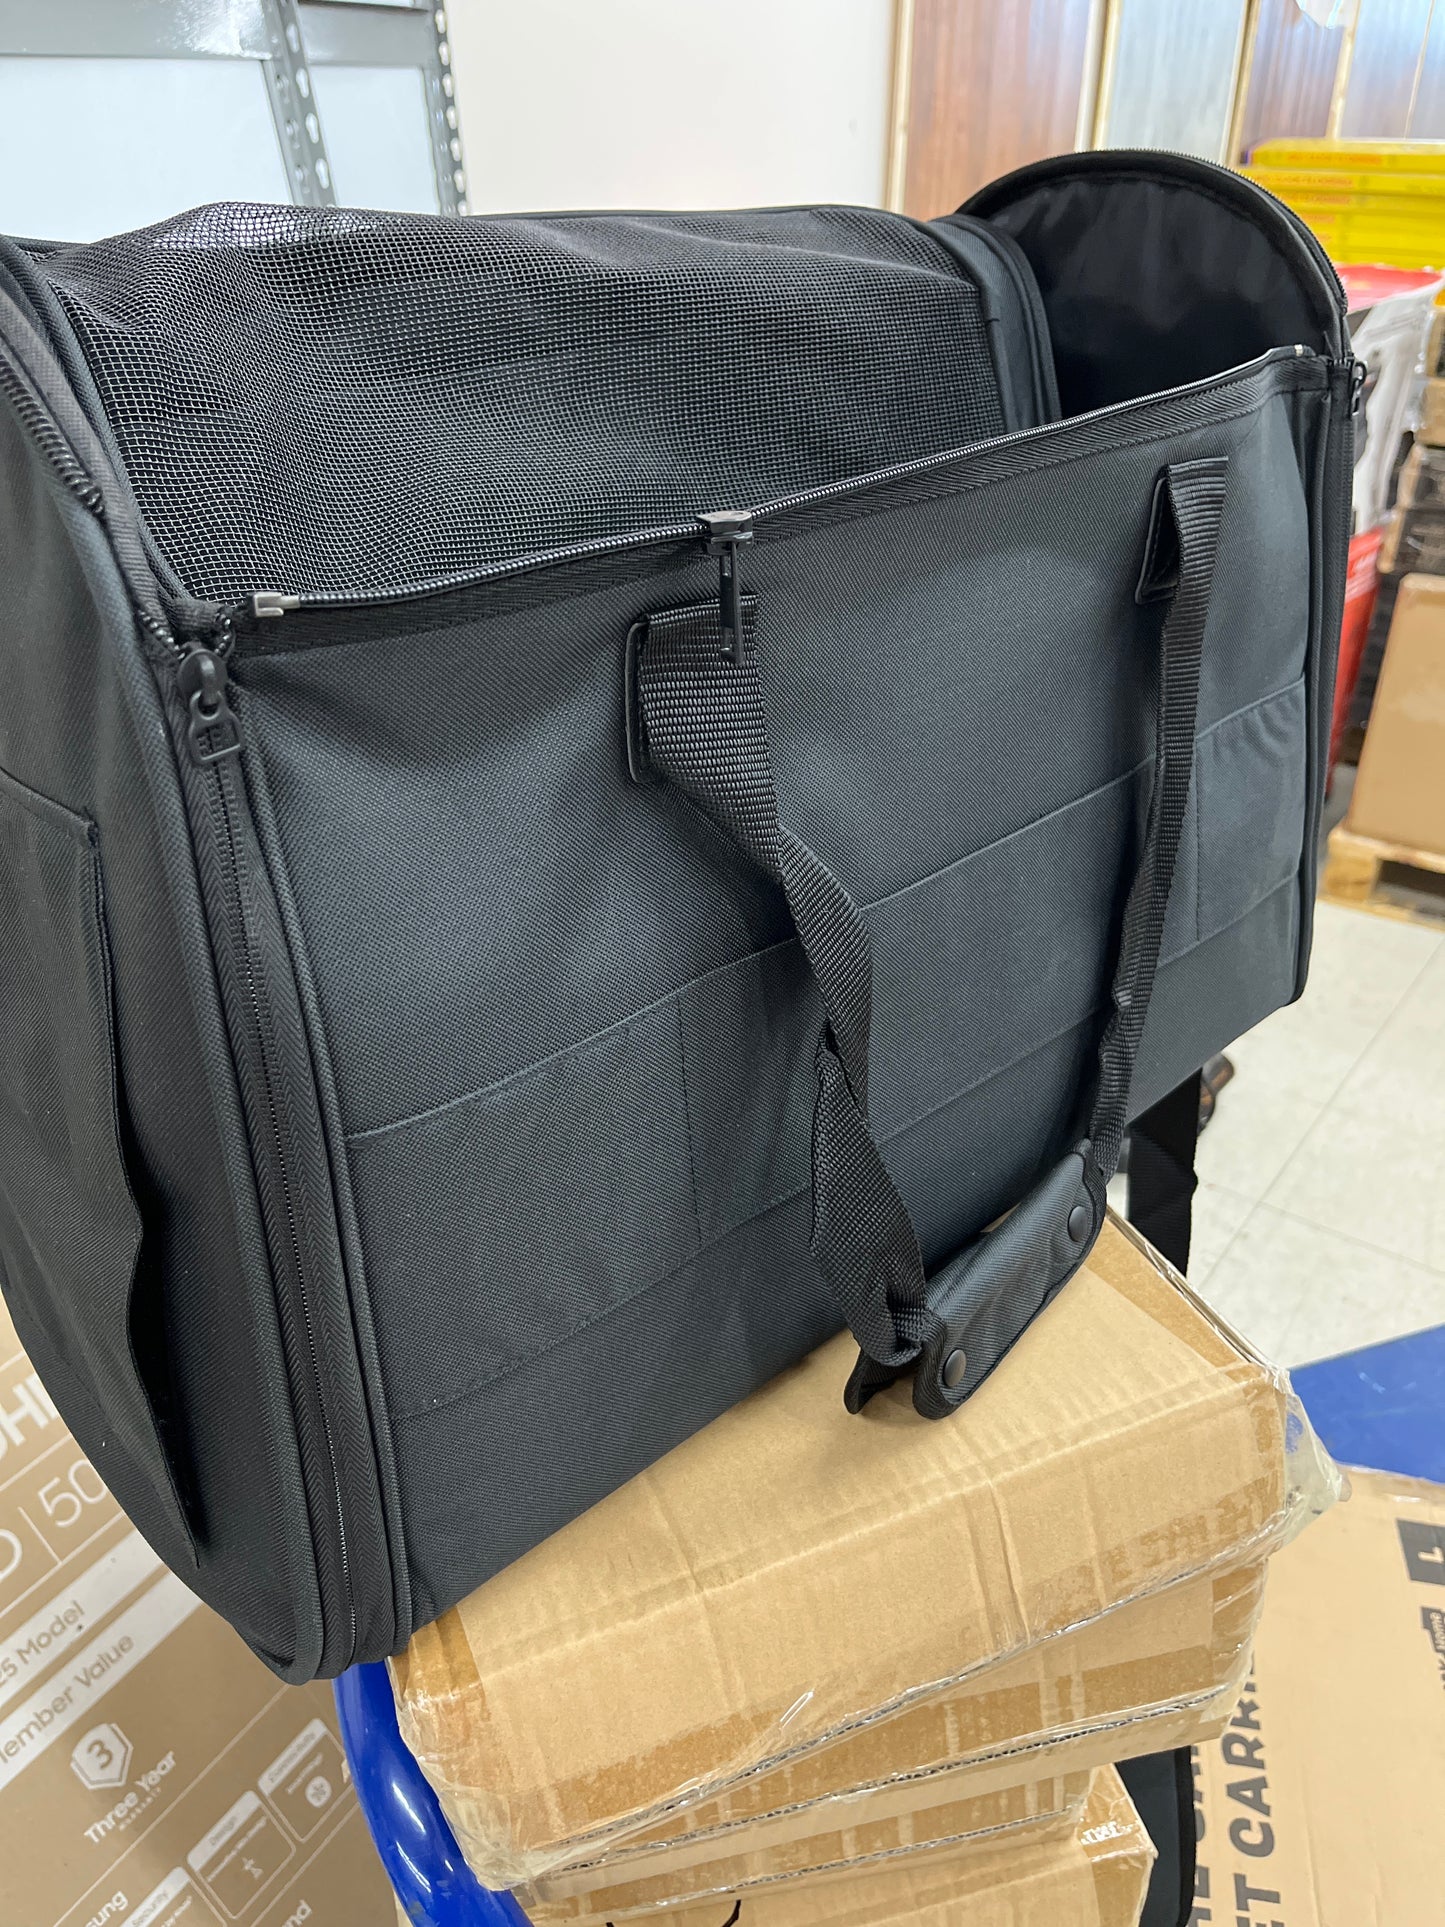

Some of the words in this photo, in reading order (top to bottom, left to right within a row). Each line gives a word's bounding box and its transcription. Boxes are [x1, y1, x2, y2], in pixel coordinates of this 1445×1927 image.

[1417, 1547, 1444, 1564] L
[16, 1600, 85, 1665] Model
[74, 1636, 135, 1688] Value
[88, 1740, 113, 1770] 3
[84, 1792, 138, 1843] Three
[135, 1751, 176, 1791] Year
